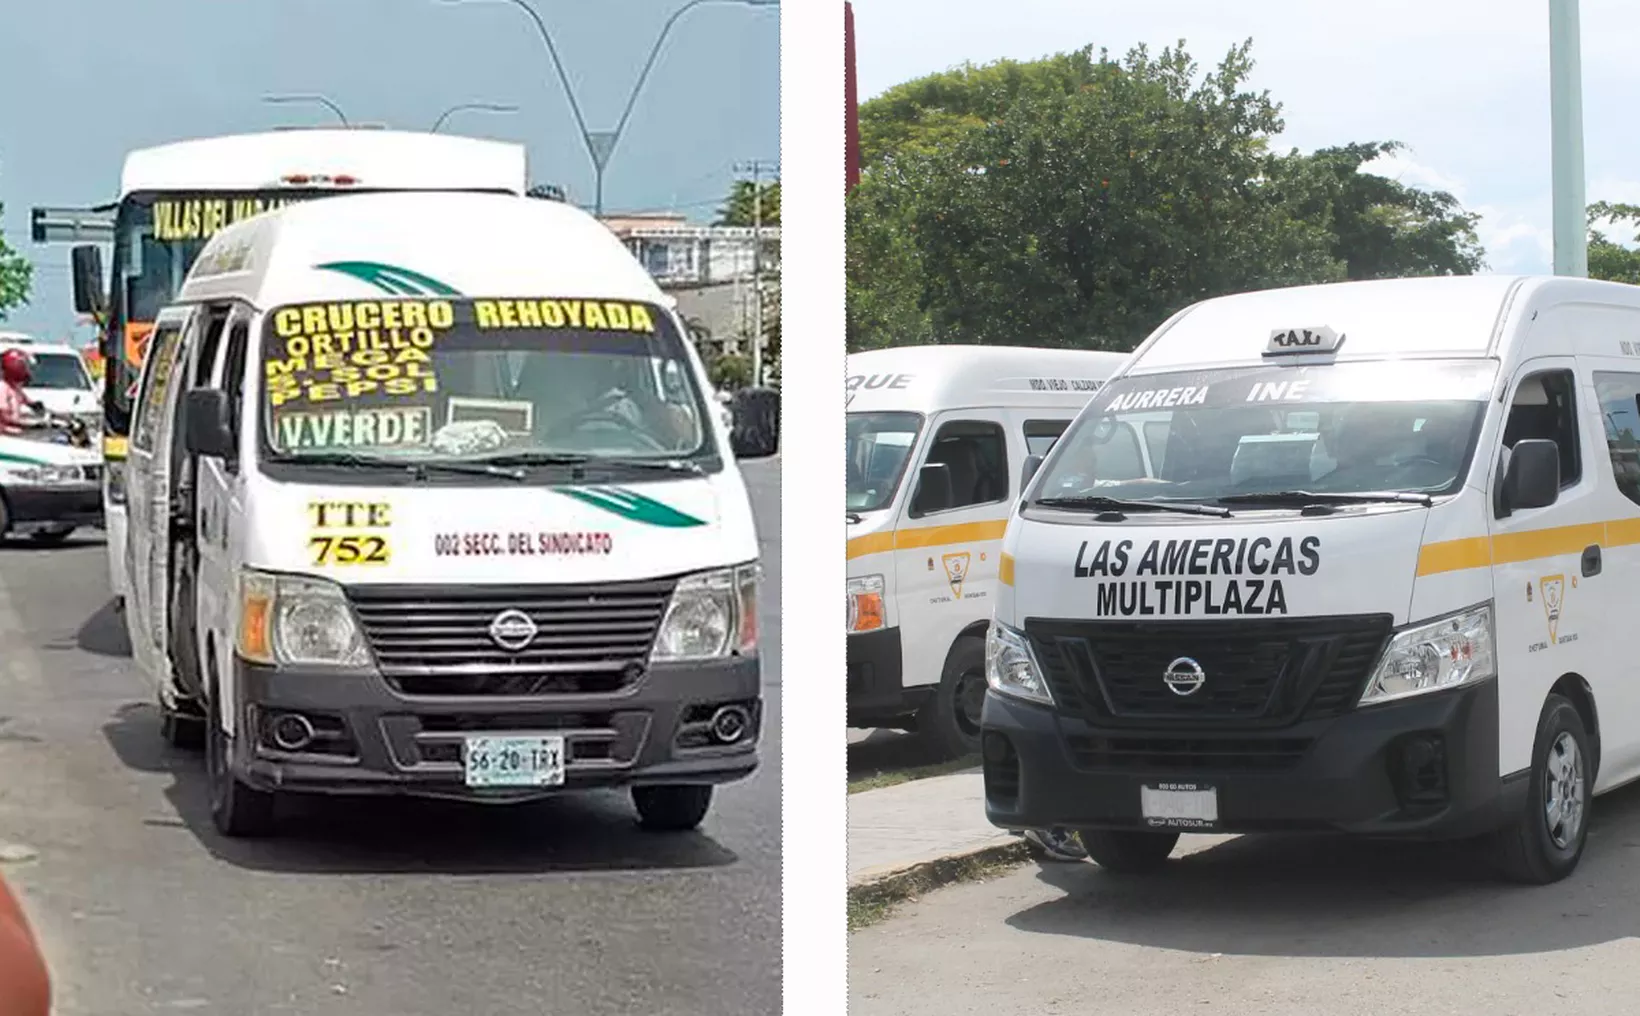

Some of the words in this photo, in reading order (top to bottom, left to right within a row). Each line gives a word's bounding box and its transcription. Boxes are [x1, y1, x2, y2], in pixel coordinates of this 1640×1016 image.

[275, 301, 454, 337] CRUCERO
[474, 300, 655, 333] REHOYADA
[286, 327, 434, 357] ORTILLO
[265, 347, 431, 376] MEGA
[272, 377, 438, 406] PEPSI
[1104, 386, 1209, 412] AURRERA
[1246, 379, 1312, 402] INE
[281, 411, 424, 448] V.VERDE
[309, 502, 391, 527] TTE
[309, 536, 387, 563] 752
[508, 533, 534, 555] DEL
[538, 532, 612, 555] SINDICATO
[1074, 540, 1133, 577] LAS
[1136, 536, 1321, 576] AMERICAS
[1096, 579, 1288, 616] MULTIPLAZA
